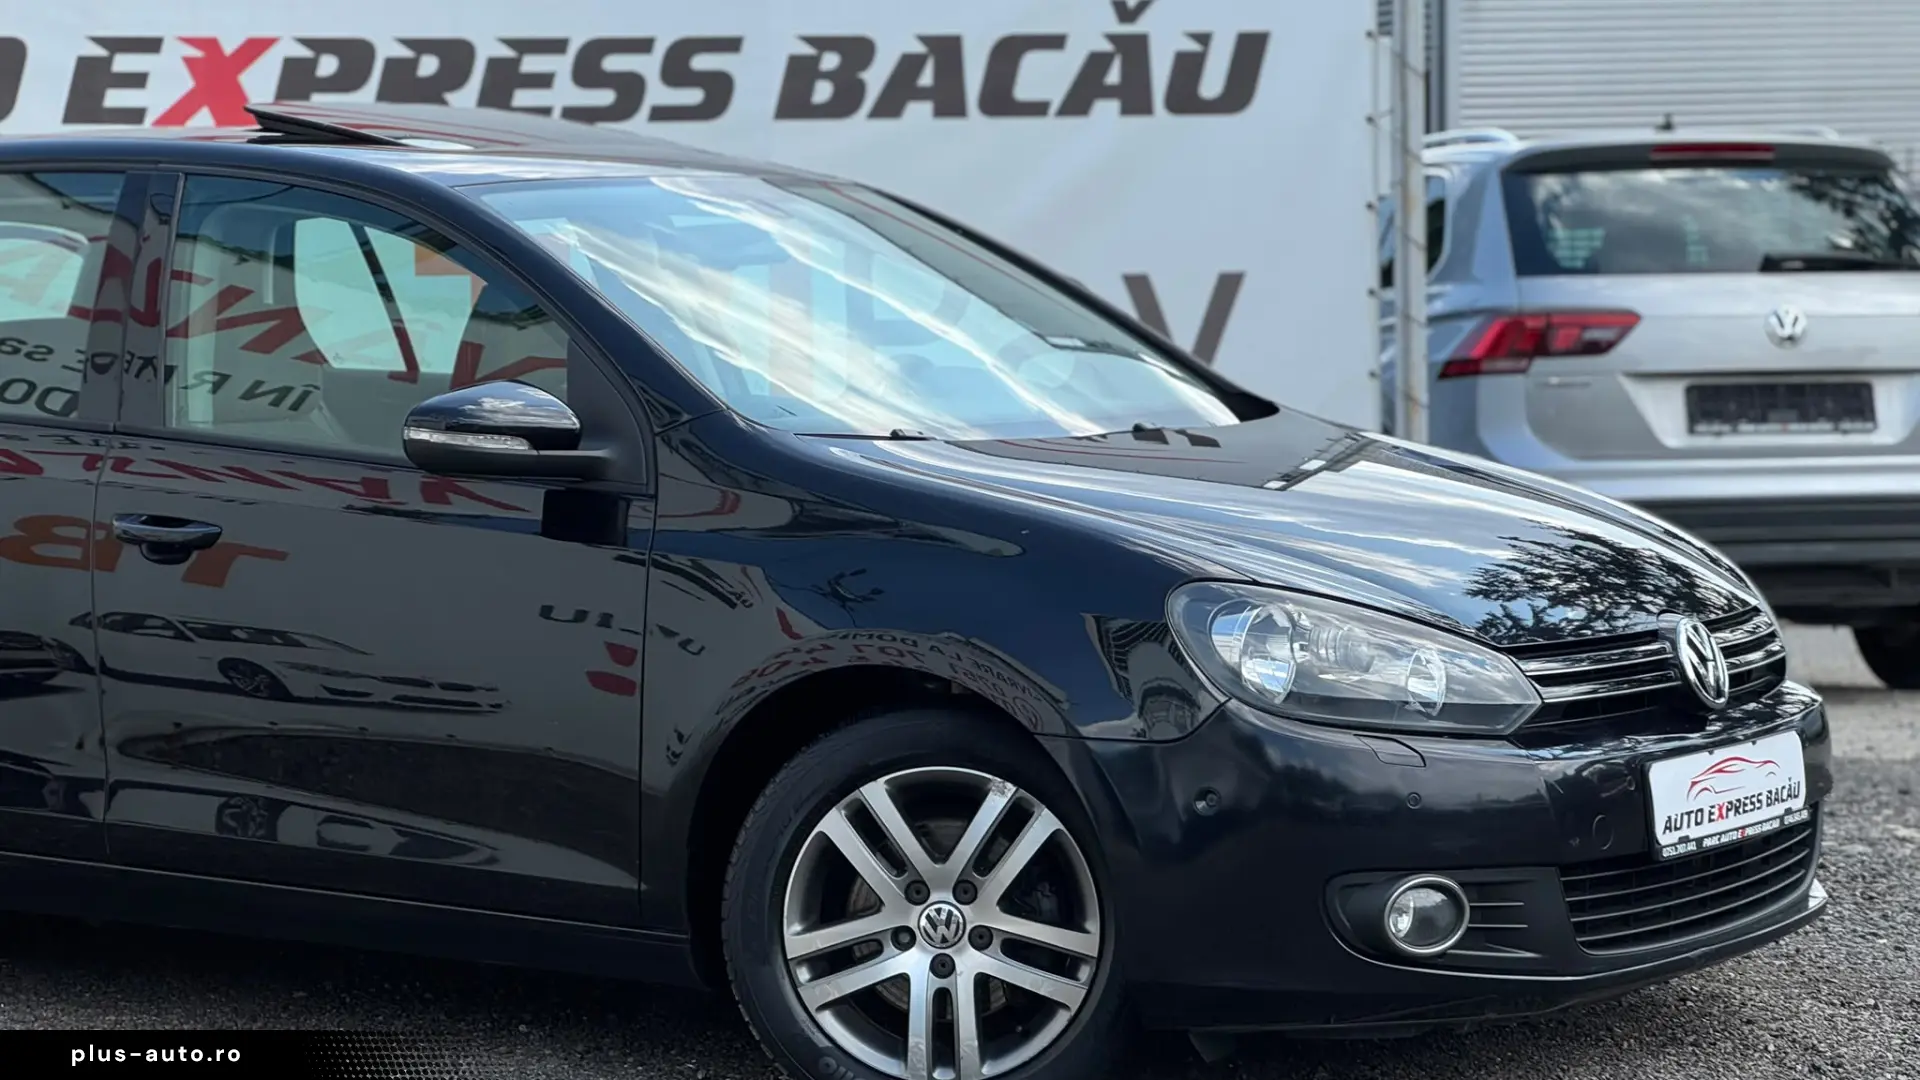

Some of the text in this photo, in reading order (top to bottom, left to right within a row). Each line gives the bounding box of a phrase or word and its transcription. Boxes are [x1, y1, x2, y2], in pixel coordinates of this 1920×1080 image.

[62, 36, 744, 127] EXPRESS
[773, 0, 1271, 120] BACĂU
[1662, 808, 1704, 835] AUTO
[1708, 792, 1764, 824] EXPRESS
